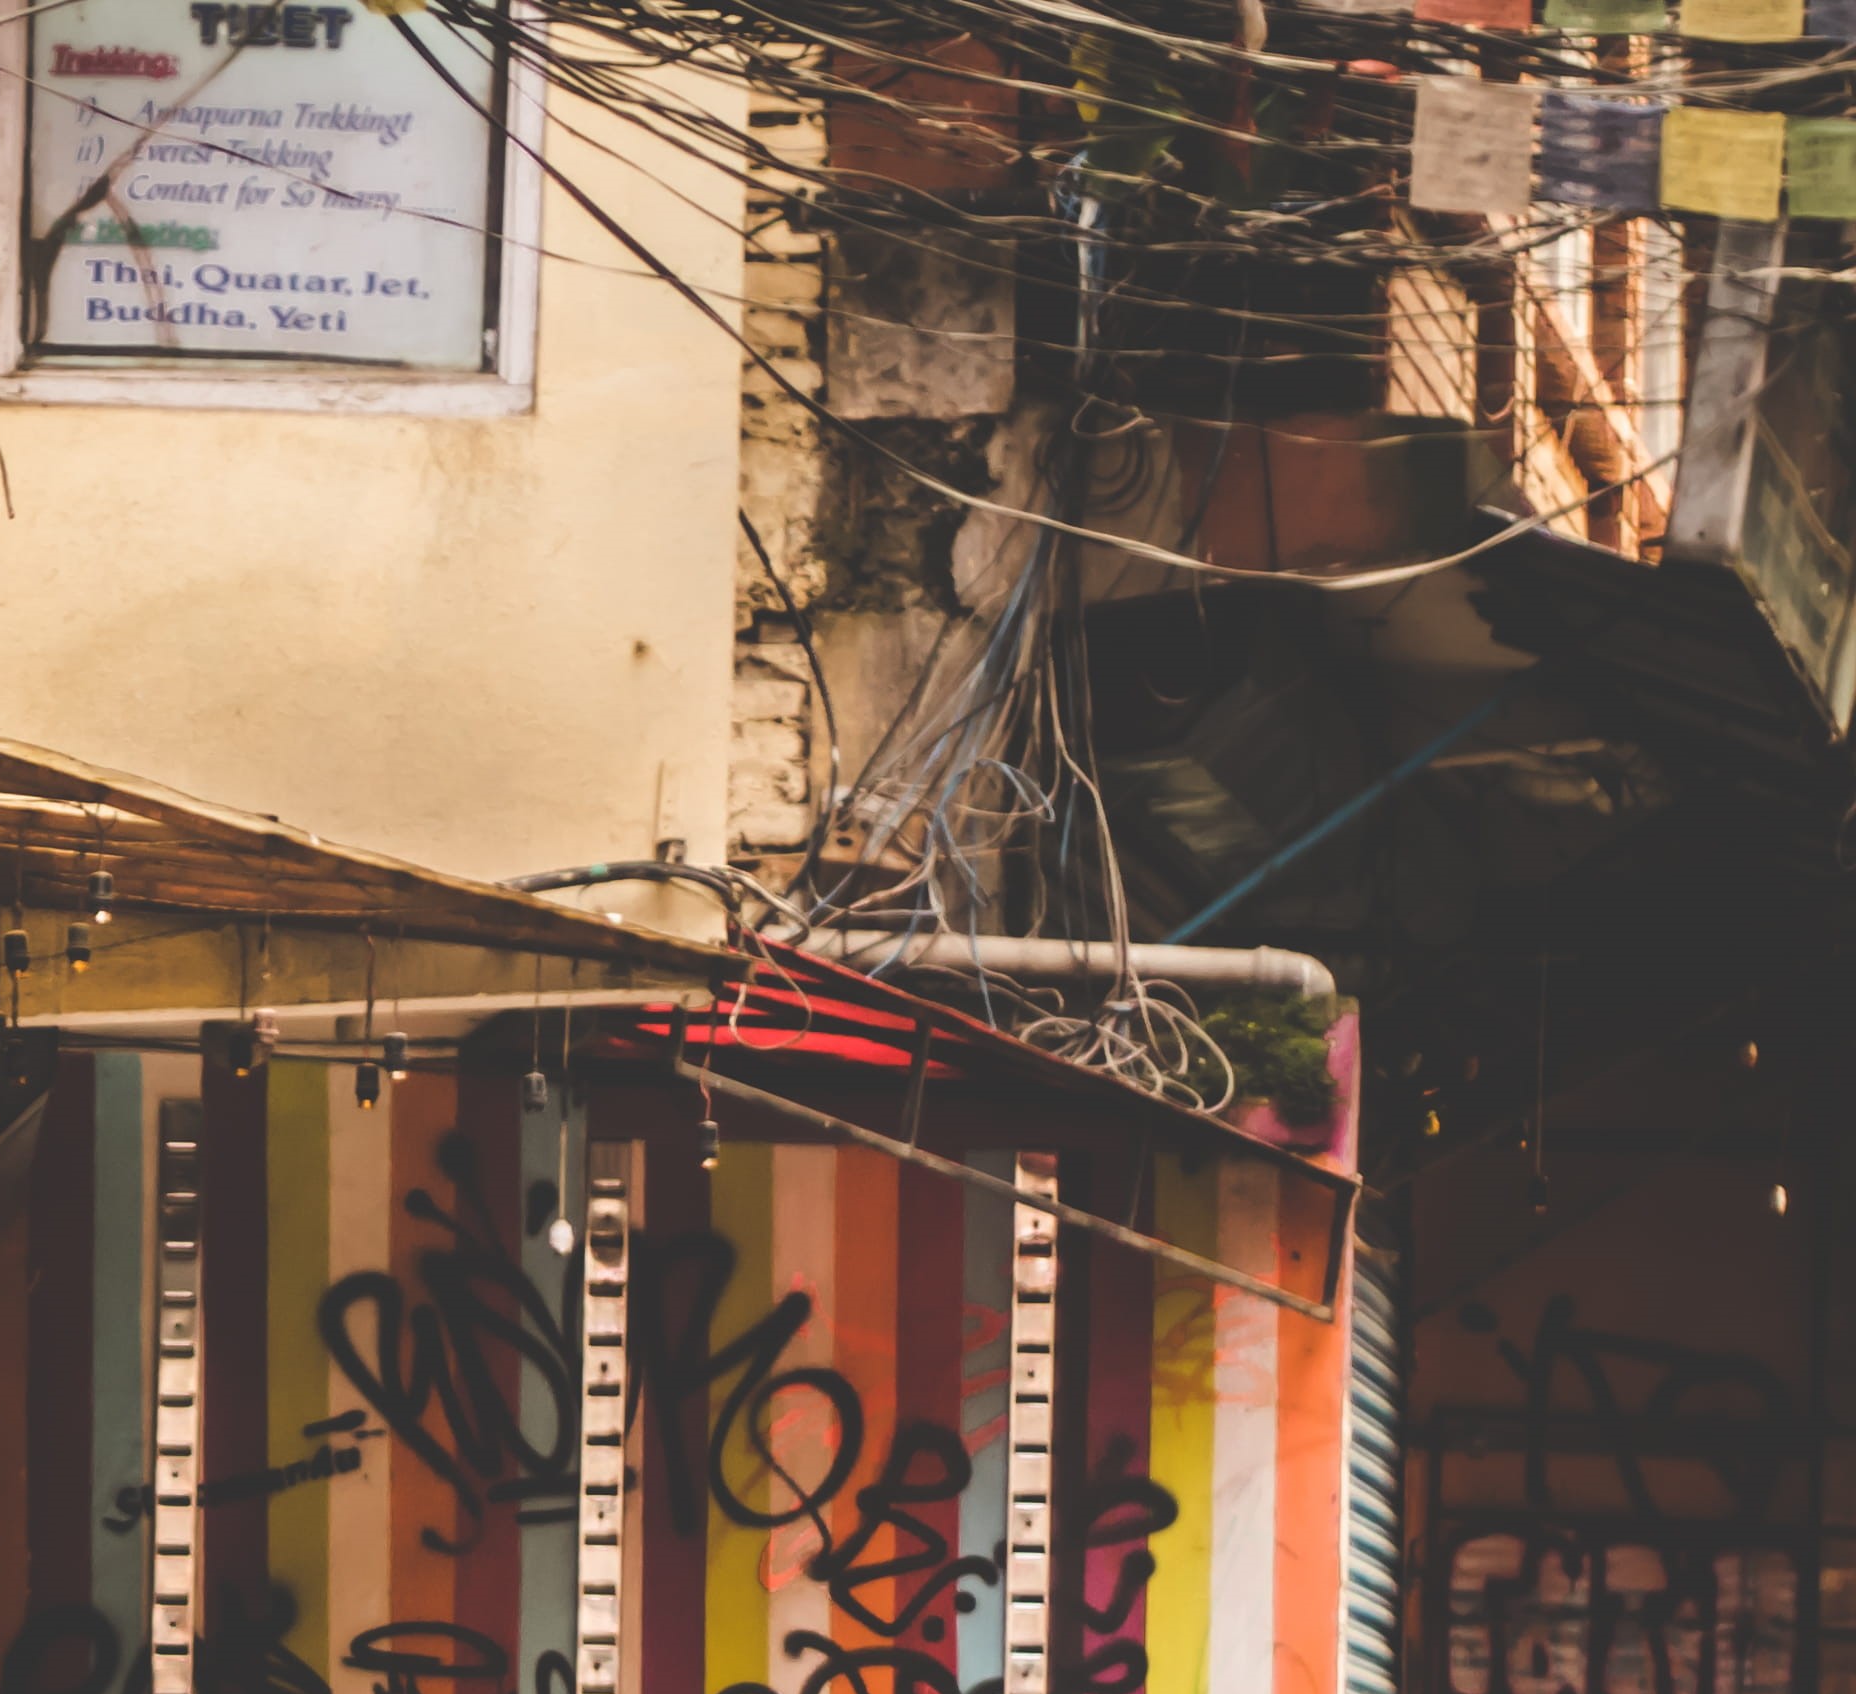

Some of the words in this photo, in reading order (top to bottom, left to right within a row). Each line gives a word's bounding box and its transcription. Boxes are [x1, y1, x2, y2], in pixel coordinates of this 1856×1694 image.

[127, 175, 231, 204] Contact
[234, 176, 276, 211] for
[281, 181, 316, 208] So
[268, 304, 348, 332] Yeti
